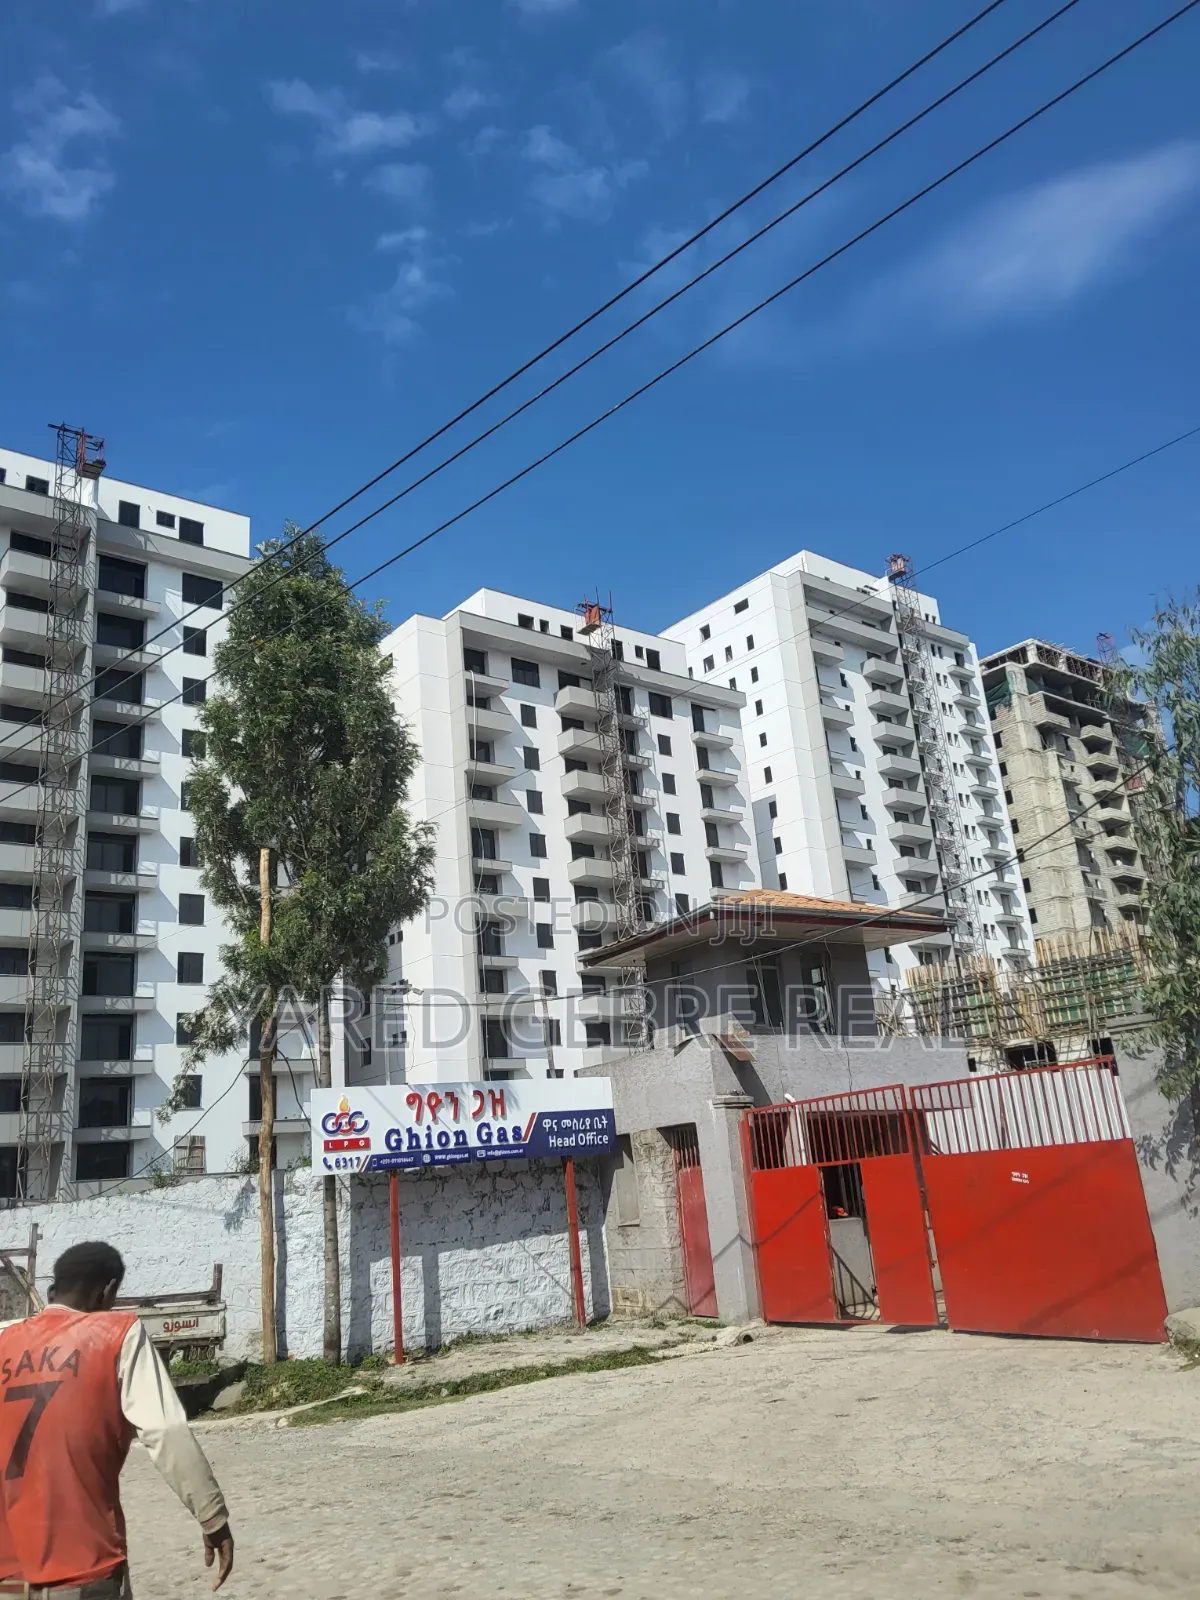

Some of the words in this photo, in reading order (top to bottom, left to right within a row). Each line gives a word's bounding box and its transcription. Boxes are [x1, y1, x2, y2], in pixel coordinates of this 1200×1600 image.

[385, 1124, 468, 1152] Ghion
[476, 1122, 523, 1145] Gas
[548, 1133, 576, 1148] Head
[577, 1131, 609, 1146] Office
[334, 1156, 361, 1169] 6317
[1, 1346, 81, 1385] SAKA
[4, 1380, 63, 1481] 7
